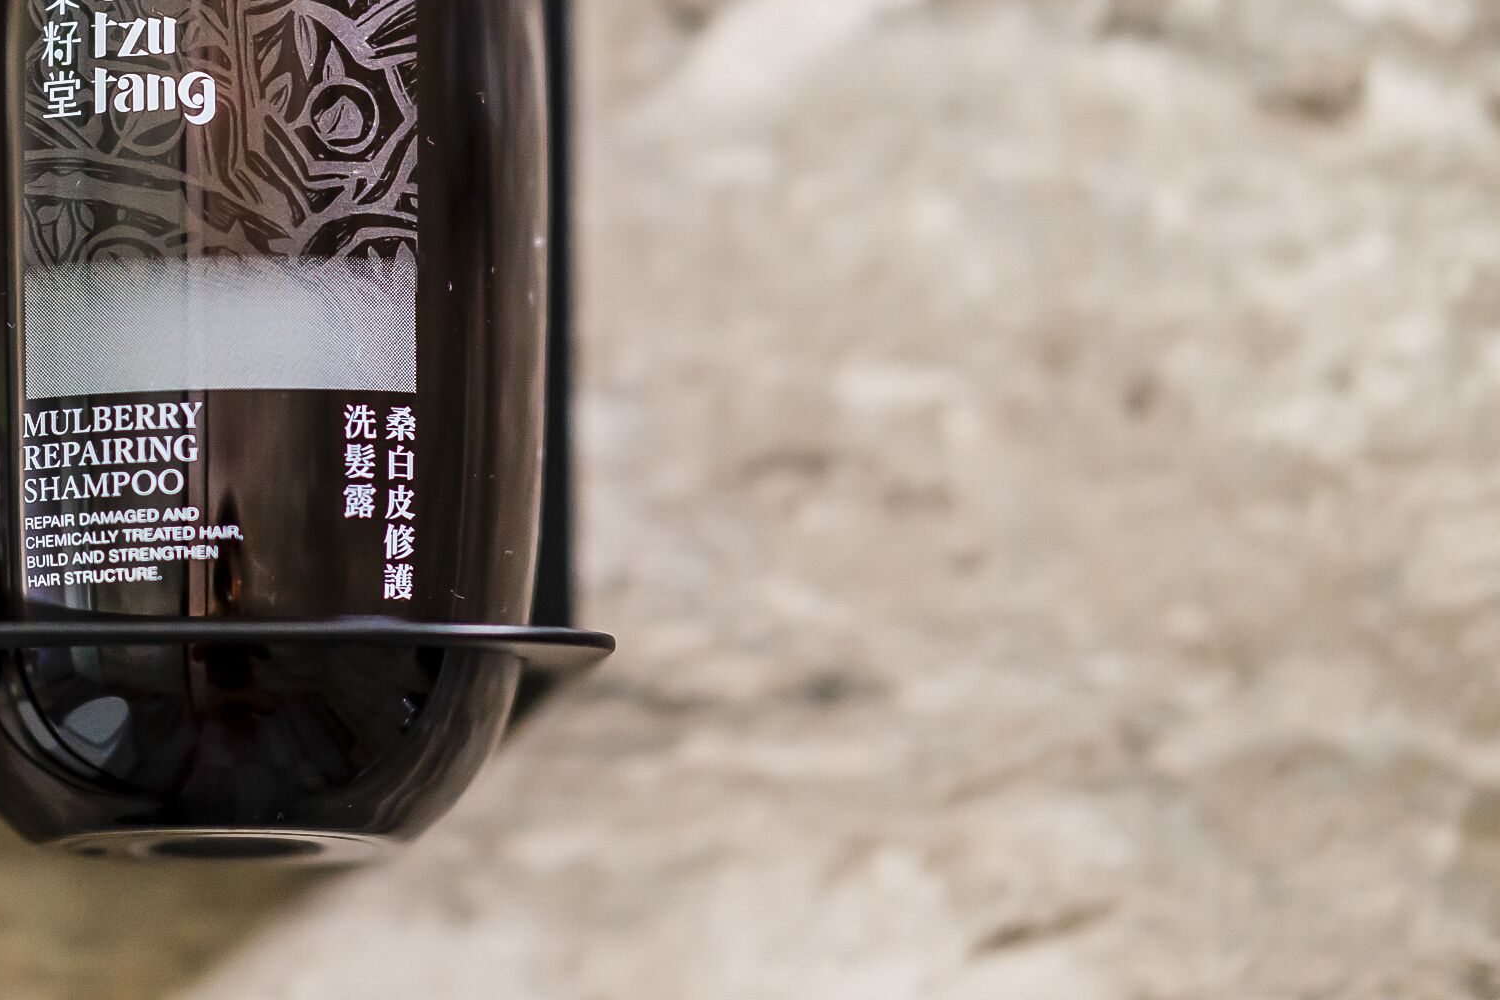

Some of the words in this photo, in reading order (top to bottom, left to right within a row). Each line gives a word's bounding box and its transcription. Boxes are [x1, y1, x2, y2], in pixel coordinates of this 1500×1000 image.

[91, 11, 177, 58] tzu
[91, 67, 216, 126] tang
[22, 402, 202, 438] MULBERRY
[23, 434, 200, 471] REPAIRING
[343, 404, 377, 519] 洗髮露
[23, 468, 185, 504] SHAMPOO
[383, 406, 417, 600] 桑白皮修護
[24, 513, 76, 531] REPAIR
[78, 508, 161, 527] DAMAGED
[162, 506, 200, 522] AND
[25, 529, 119, 550] CHEMICALLY
[122, 526, 196, 543] TREATED
[199, 525, 245, 541] HAIR,
[26, 551, 69, 569] BUILD
[71, 549, 106, 565] AND
[108, 545, 219, 563] STRENGTHEN
[27, 572, 61, 588] HAIR
[63, 566, 163, 586] STRUCTURE.
